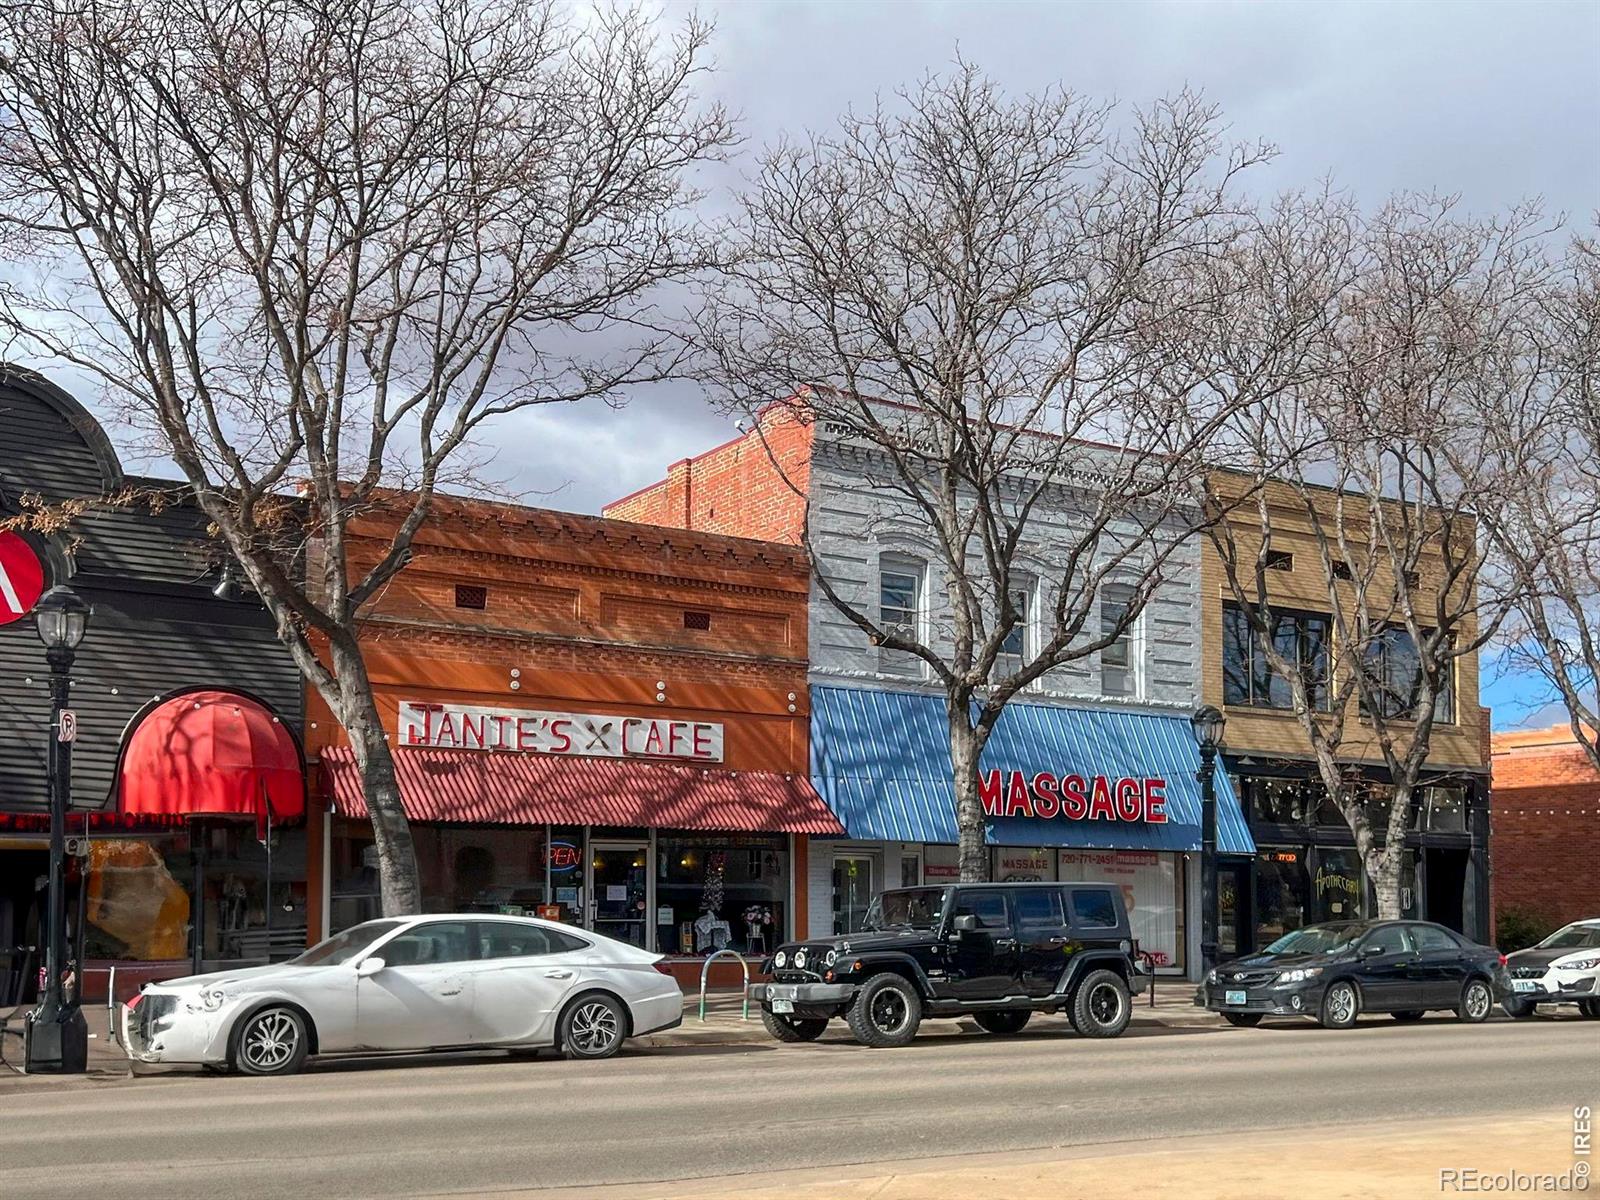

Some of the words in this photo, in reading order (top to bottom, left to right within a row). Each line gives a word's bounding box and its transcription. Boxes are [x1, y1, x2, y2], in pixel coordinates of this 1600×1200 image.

[621, 718, 713, 756] CAFE
[978, 768, 1169, 824] MASSAGE
[1002, 859, 1048, 869] MASSAGE
